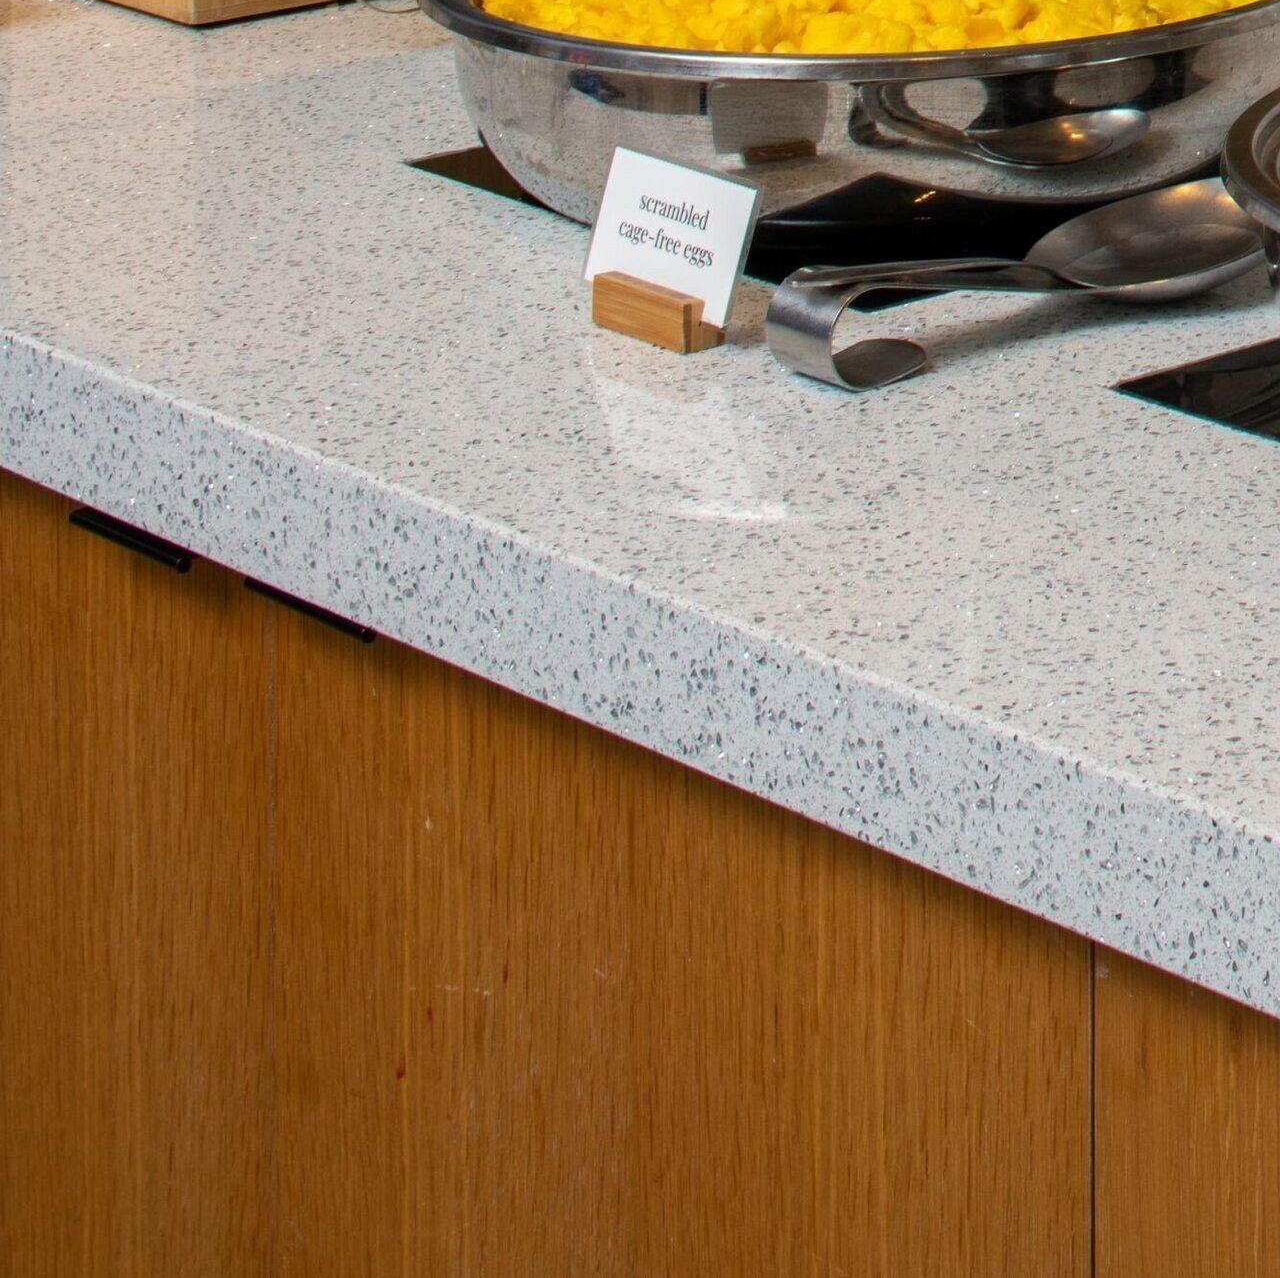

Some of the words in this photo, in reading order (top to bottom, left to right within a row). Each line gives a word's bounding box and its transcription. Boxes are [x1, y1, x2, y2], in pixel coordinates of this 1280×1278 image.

[639, 194, 710, 230] scrambled
[618, 221, 682, 257] cage-free
[683, 243, 715, 268] eggs
